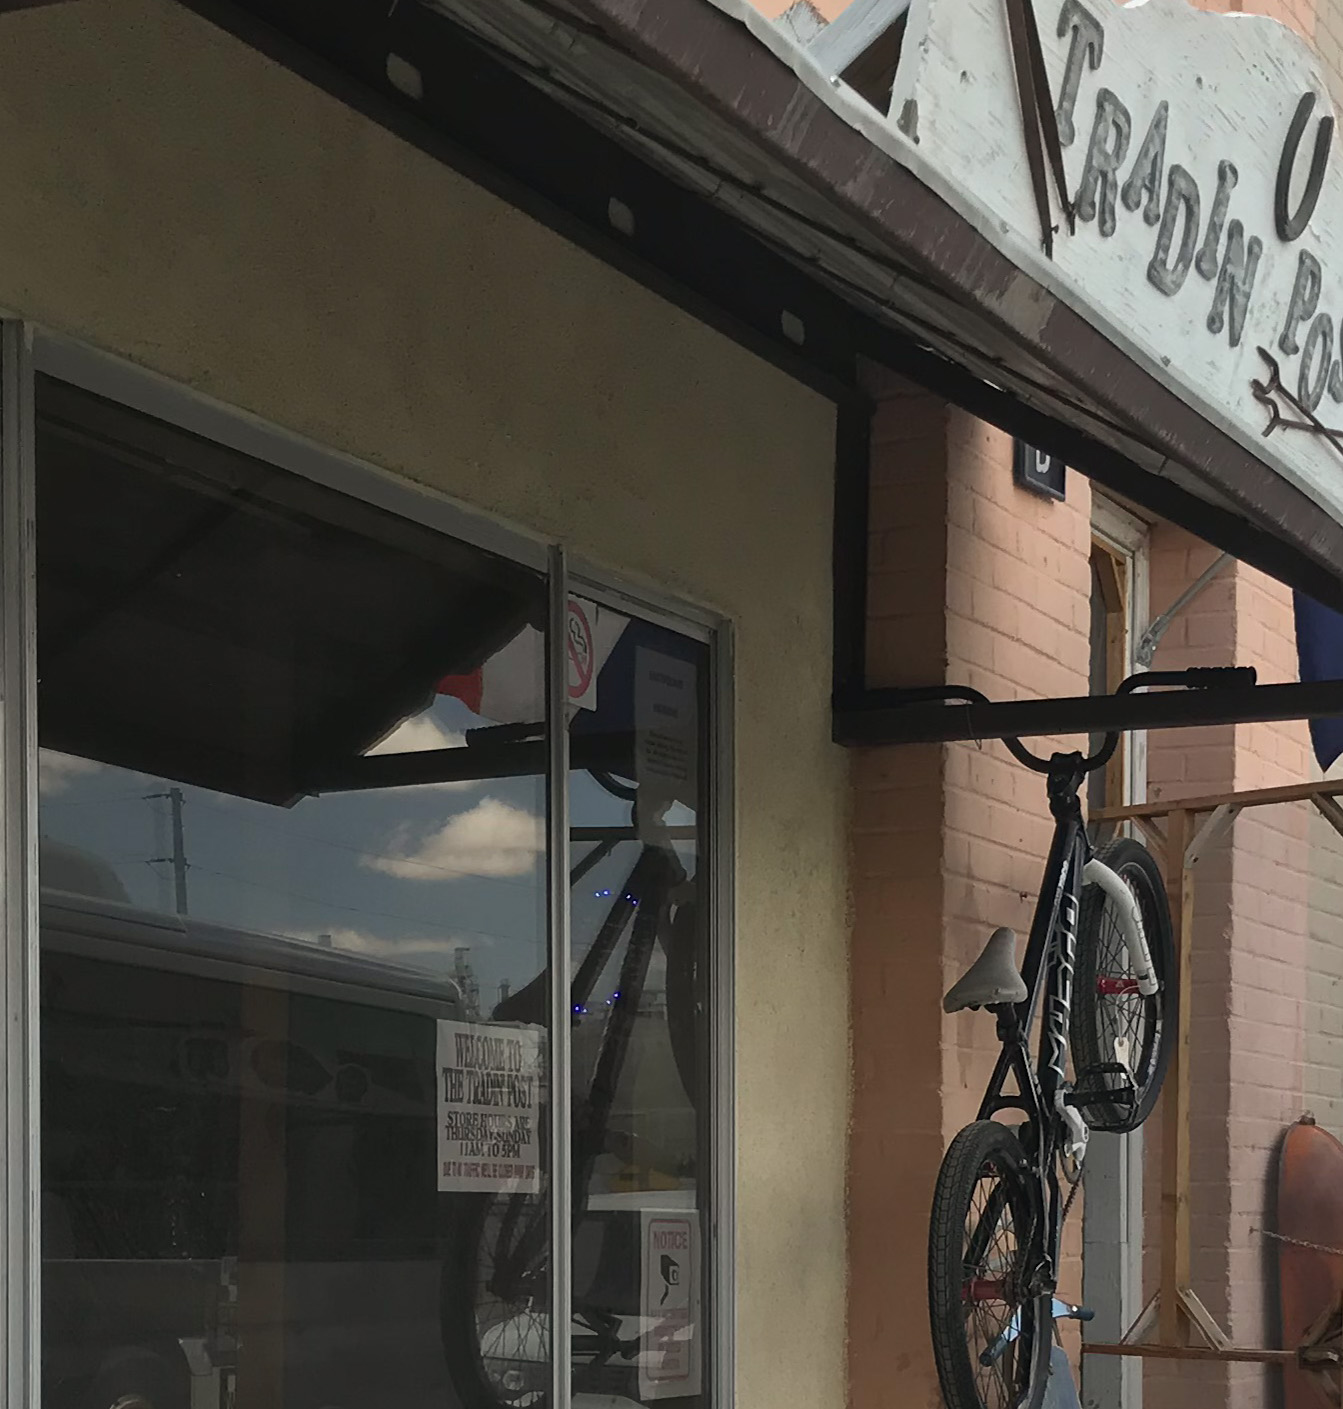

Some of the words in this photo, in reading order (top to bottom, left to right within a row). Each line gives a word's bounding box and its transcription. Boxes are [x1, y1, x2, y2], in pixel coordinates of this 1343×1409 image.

[1057, 0, 1262, 348] TRADIN
[454, 1032, 505, 1071] WELCOME
[506, 1038, 522, 1073] TO
[442, 1066, 464, 1103] THE
[507, 1072, 533, 1109] POST
[447, 1111, 479, 1127] STORE
[500, 1143, 521, 1159] 5PM
[652, 1230, 688, 1251] NOTICE
